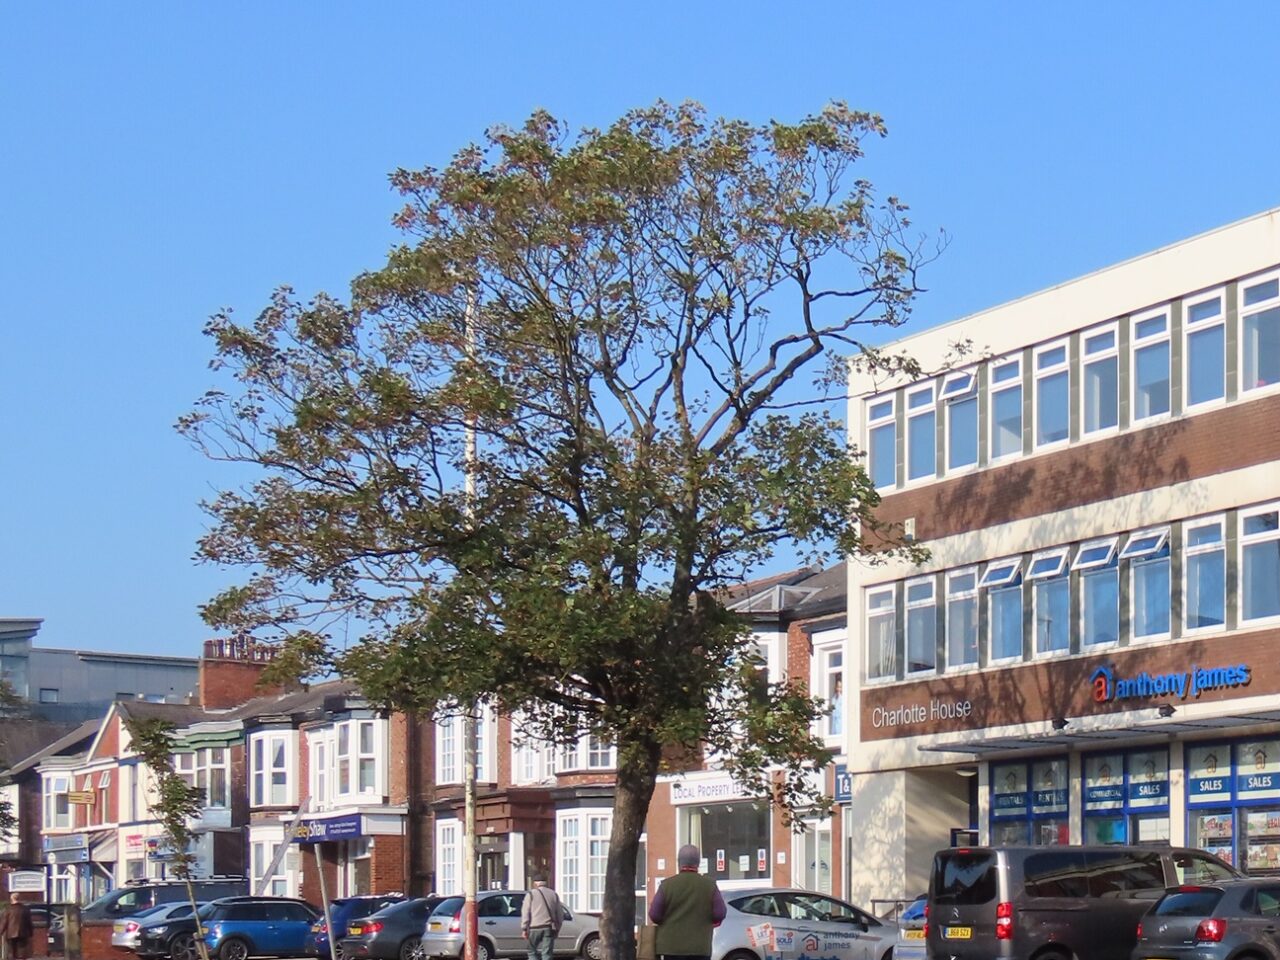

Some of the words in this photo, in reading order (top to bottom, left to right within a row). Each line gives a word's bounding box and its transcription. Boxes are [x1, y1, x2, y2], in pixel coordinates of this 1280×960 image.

[1115, 672, 1188, 699] anthony
[1190, 663, 1249, 698] james
[872, 704, 927, 728] Charlotte
[930, 699, 972, 721] House
[1200, 780, 1223, 791] SALES
[1248, 776, 1273, 788] SALES
[674, 787, 695, 799] LOCAL
[698, 784, 729, 797] PROPERTY
[1139, 785, 1160, 796] SALES
[776, 936, 792, 944] SOLD
[823, 931, 860, 940] anthony
[823, 941, 851, 951] james
